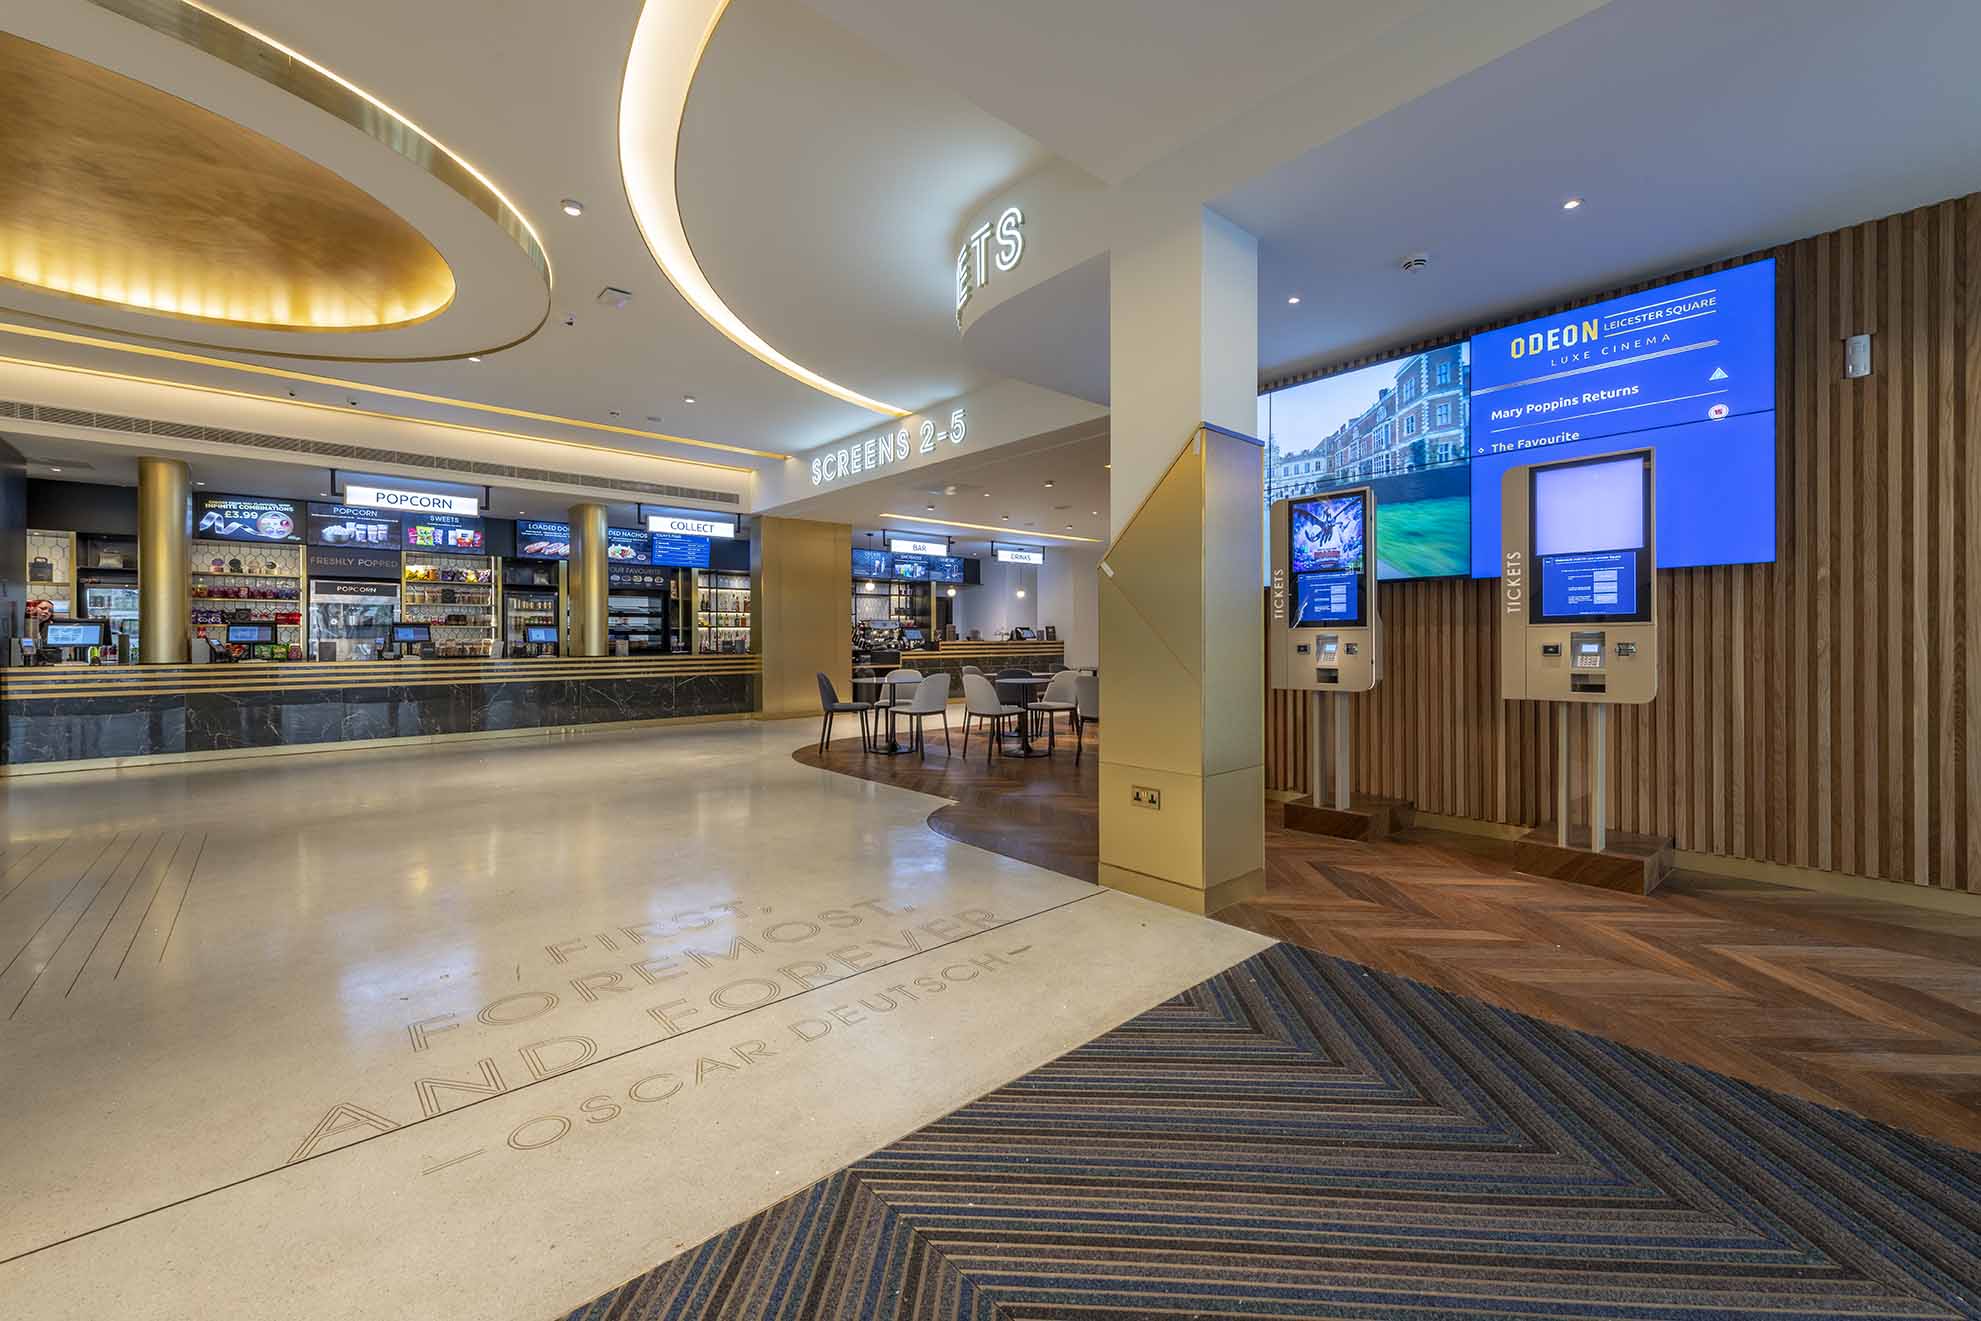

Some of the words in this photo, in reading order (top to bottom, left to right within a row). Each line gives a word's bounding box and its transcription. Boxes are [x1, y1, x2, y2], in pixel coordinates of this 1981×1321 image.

[1510, 318, 1600, 360] ODEON
[1603, 309, 1664, 332] LEICESTER
[1665, 296, 1717, 318] SQUARE
[1550, 350, 1592, 367] LUXE
[1601, 332, 1672, 357] CINEMA
[1491, 404, 1524, 421] Mary
[1526, 394, 1579, 416] Poppins
[1582, 383, 1640, 404] Returns
[811, 428, 910, 486] SCREENS
[919, 408, 966, 454] 2-5
[1491, 439, 1515, 454] The
[1517, 430, 1580, 450] Favourite
[376, 491, 453, 510] POPCORN
[224, 510, 258, 519] £3.99
[238, 504, 295, 513] COMBINATIONS
[333, 507, 378, 518] POPCORN
[429, 515, 460, 524] SWEETS
[528, 523, 556, 532] LOADED
[670, 520, 715, 533] COLLECT
[622, 530, 648, 539] NACHOS
[912, 544, 927, 552] BAR
[310, 556, 355, 567] FRESHLY
[357, 558, 399, 568] POPPED
[1506, 551, 1521, 614] TICKETS
[336, 585, 377, 594] POPCORN
[1273, 567, 1285, 619] TICKETS
[286, 1034, 599, 1165] AND
[646, 908, 1012, 1035] FOREVER
